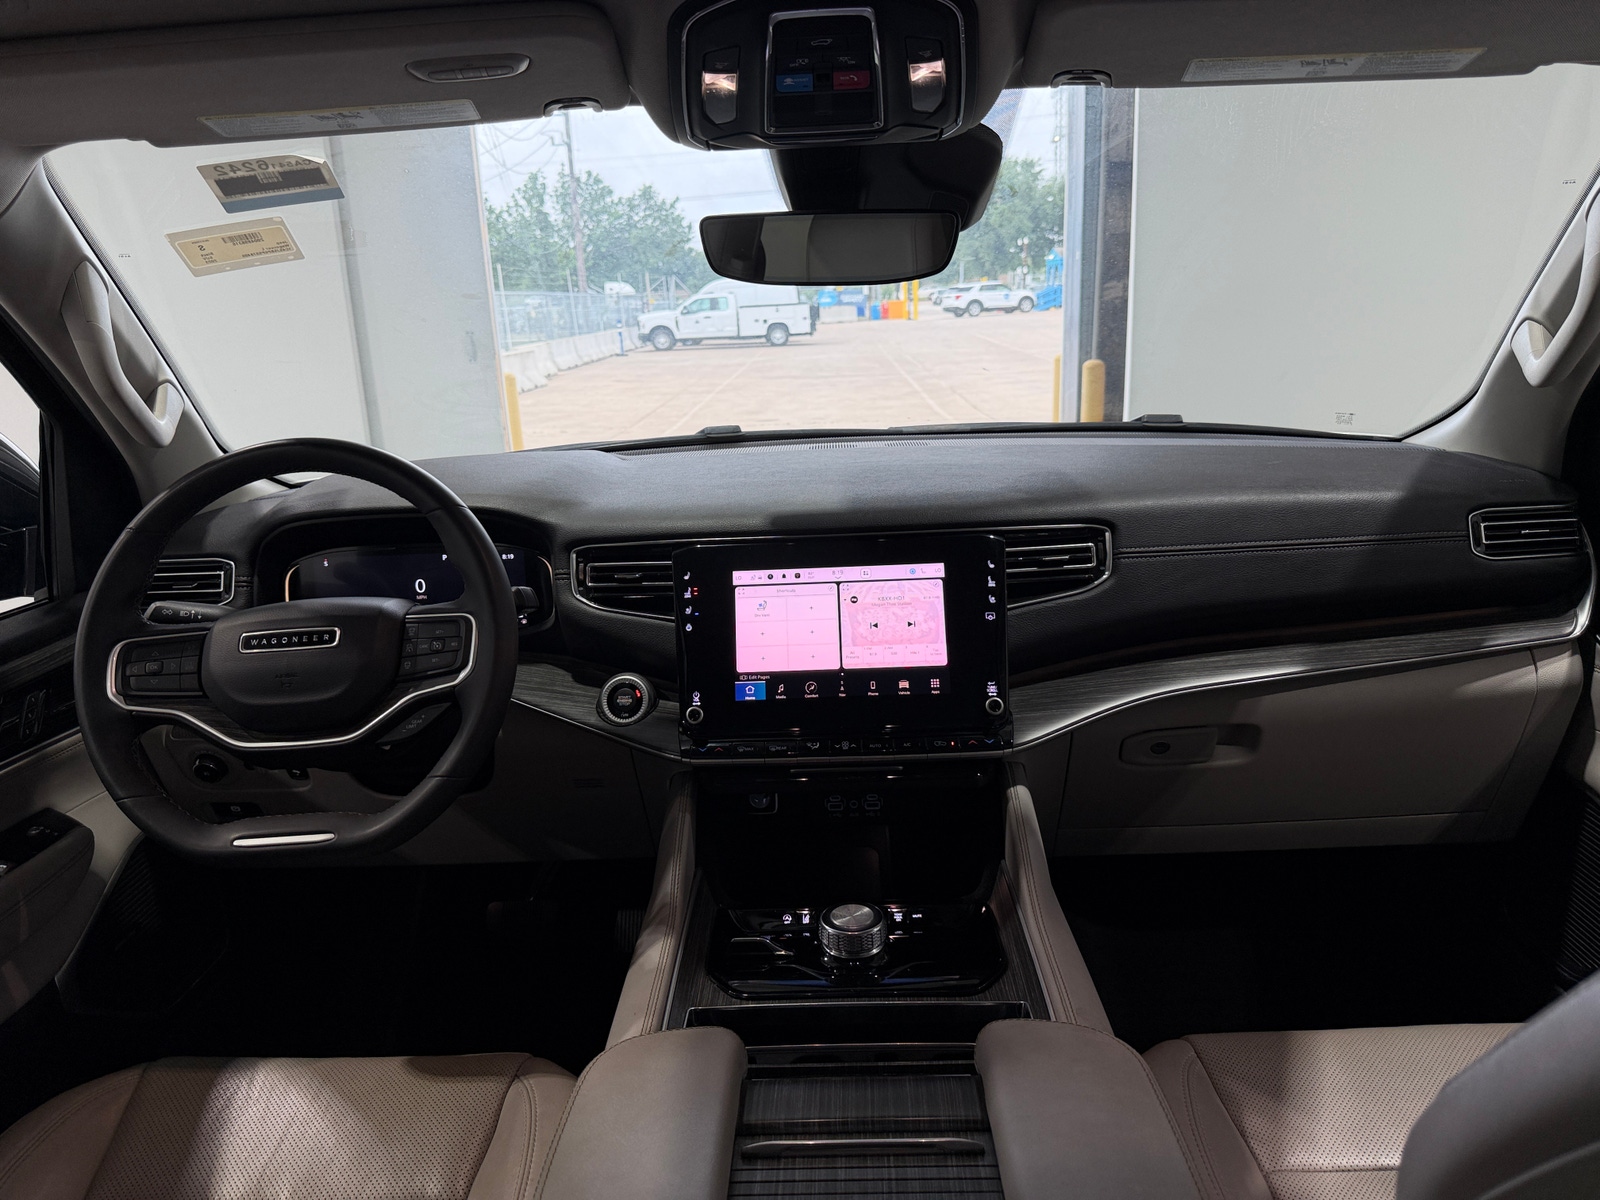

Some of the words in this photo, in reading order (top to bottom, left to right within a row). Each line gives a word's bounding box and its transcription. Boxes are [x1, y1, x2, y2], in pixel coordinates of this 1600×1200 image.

[441, 553, 448, 561] P
[414, 578, 426, 594] 0
[250, 634, 330, 646] WAGONEER
